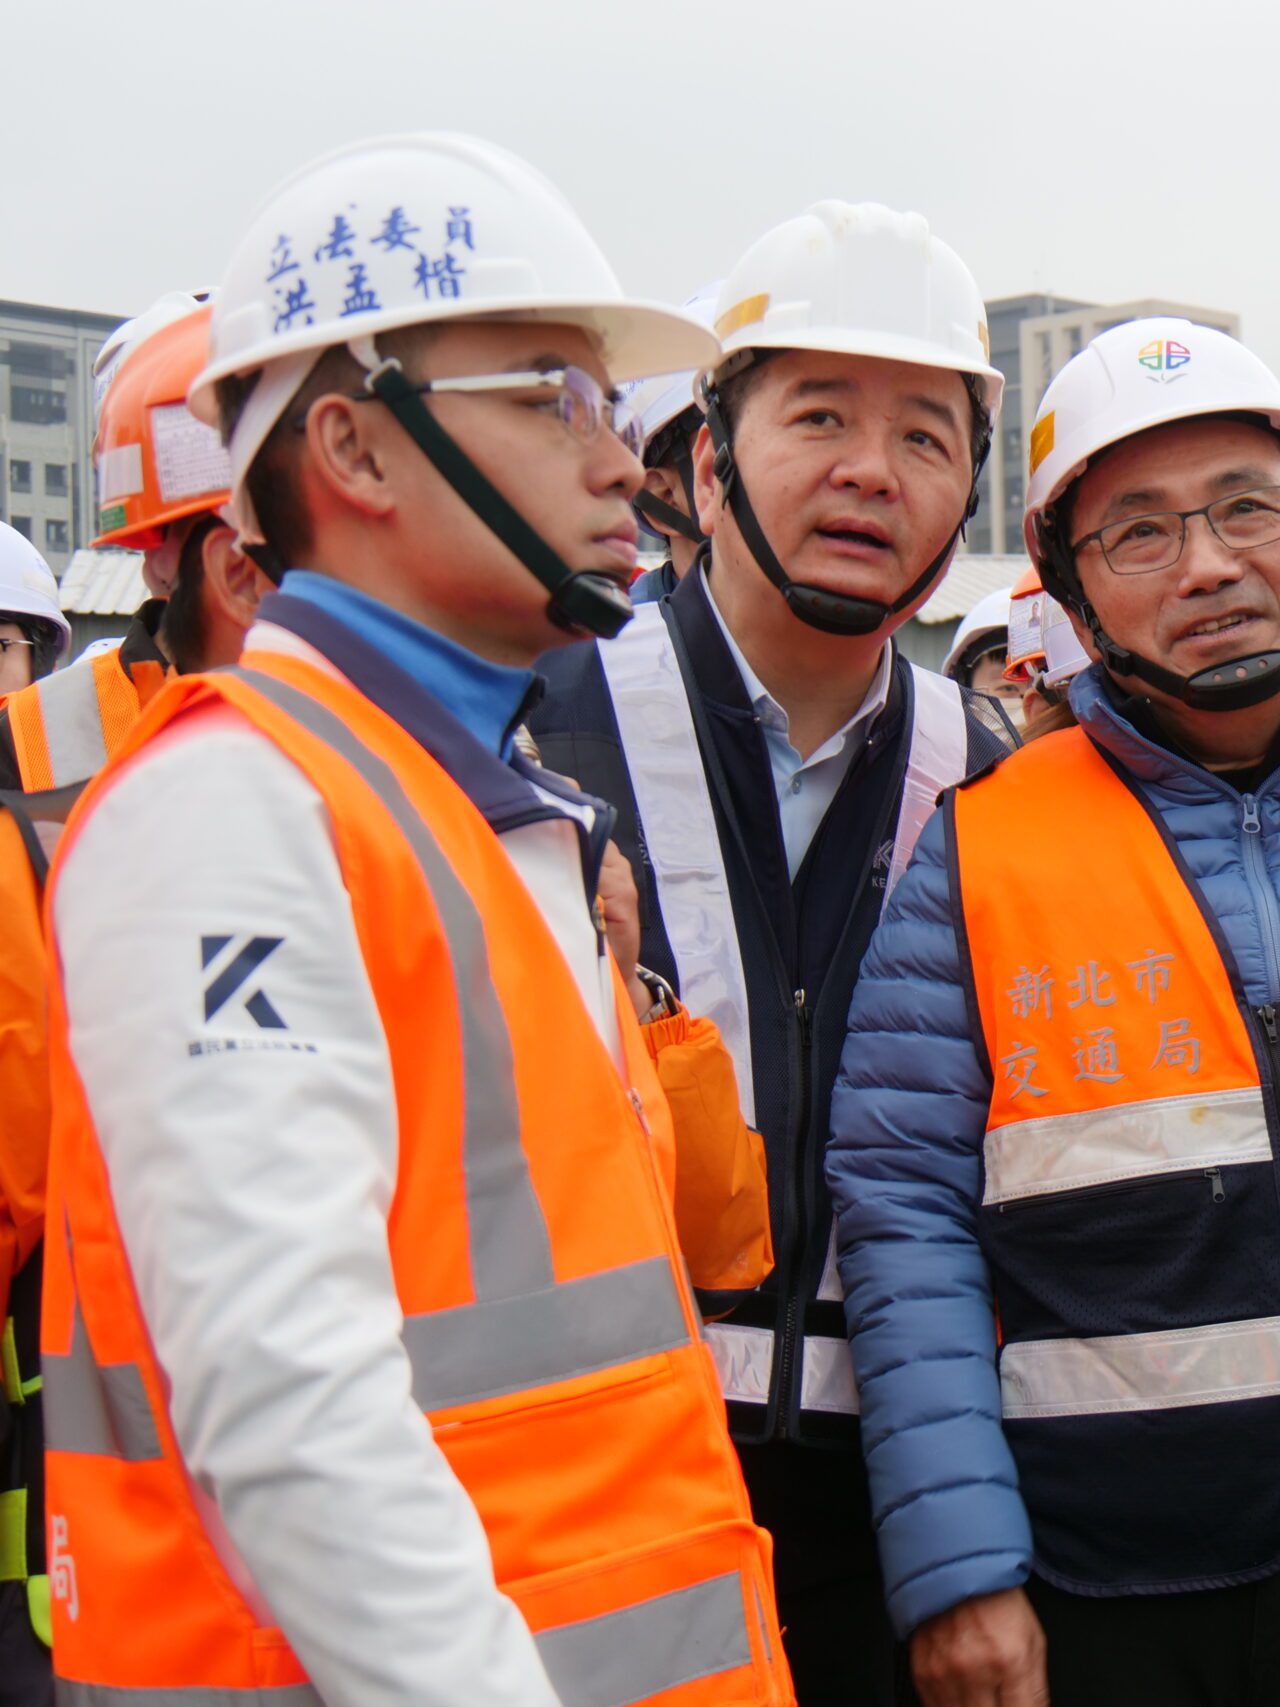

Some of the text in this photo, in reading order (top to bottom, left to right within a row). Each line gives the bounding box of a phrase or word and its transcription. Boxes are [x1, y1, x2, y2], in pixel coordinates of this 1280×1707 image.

[267, 203, 474, 282] 立法委員
[273, 253, 465, 333] 洪孟楷
[1007, 949, 1174, 1018] 新北市
[1001, 1018, 1200, 1100] 交通局
